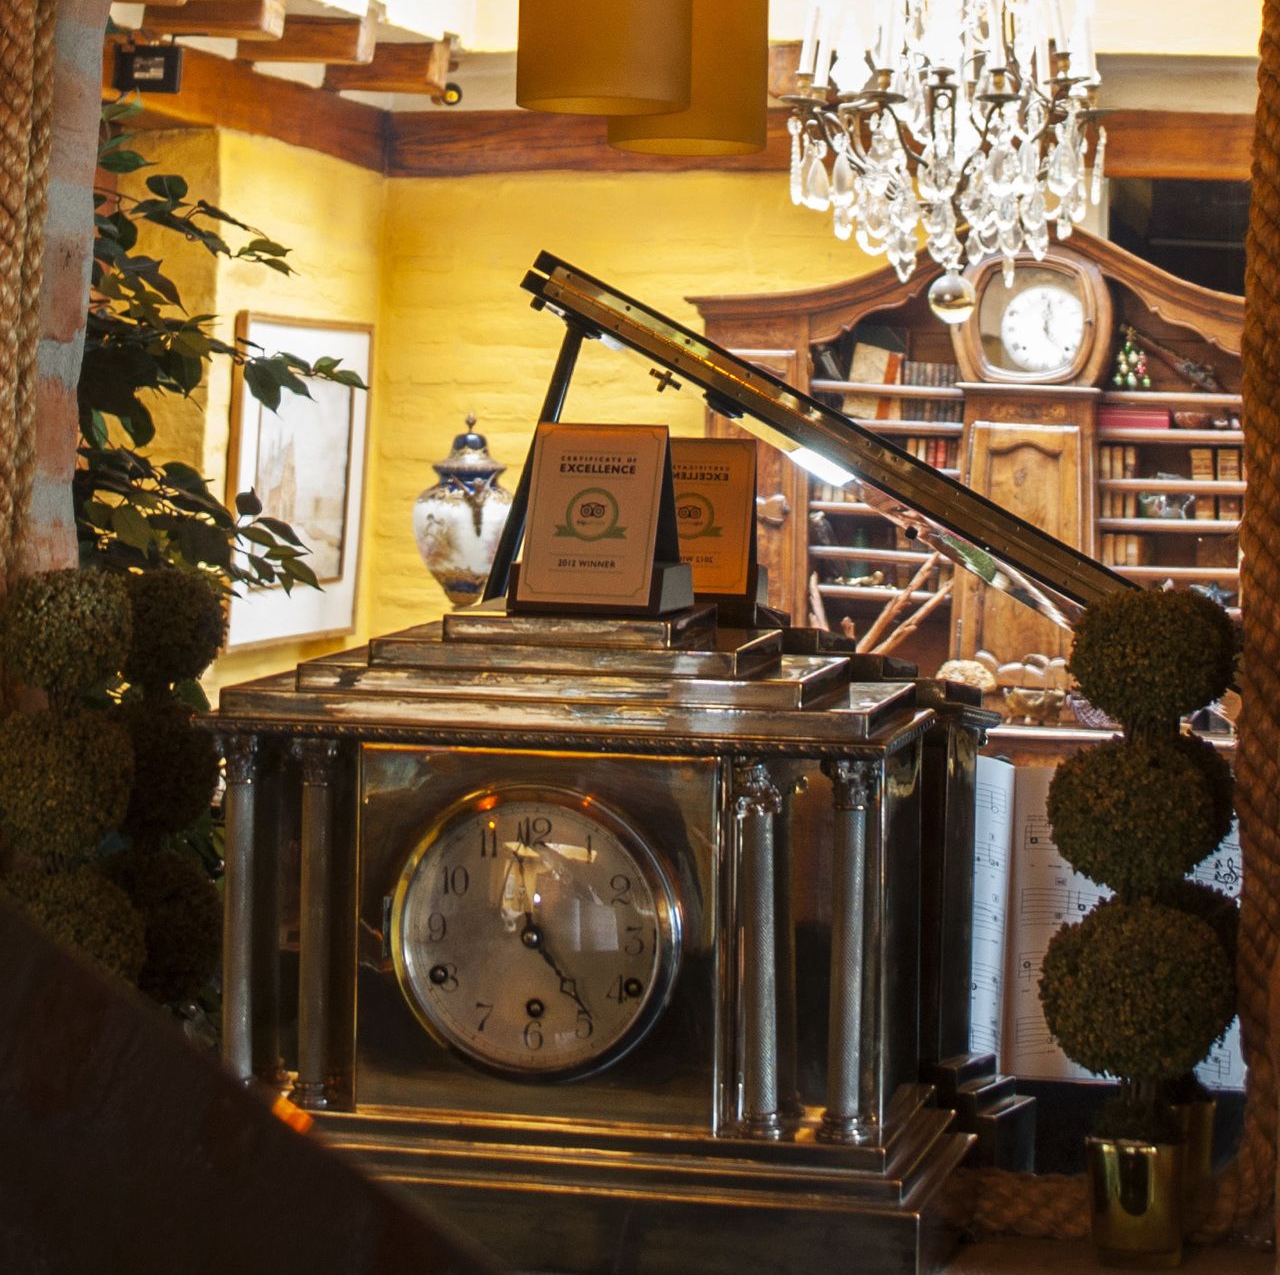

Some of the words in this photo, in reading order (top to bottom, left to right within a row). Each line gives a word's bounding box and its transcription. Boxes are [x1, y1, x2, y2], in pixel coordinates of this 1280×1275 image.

[560, 454, 622, 463] CERTIFICATE
[560, 464, 636, 475] EXCELLENCE
[578, 559, 616, 569] WINNER
[480, 828, 498, 858] 11
[441, 865, 470, 896] 10
[610, 874, 631, 906] 2
[428, 912, 447, 942] 9
[624, 926, 644, 955] 3
[475, 1002, 493, 1032] 7
[575, 1009, 594, 1038] 5
[524, 1020, 543, 1051] 6
